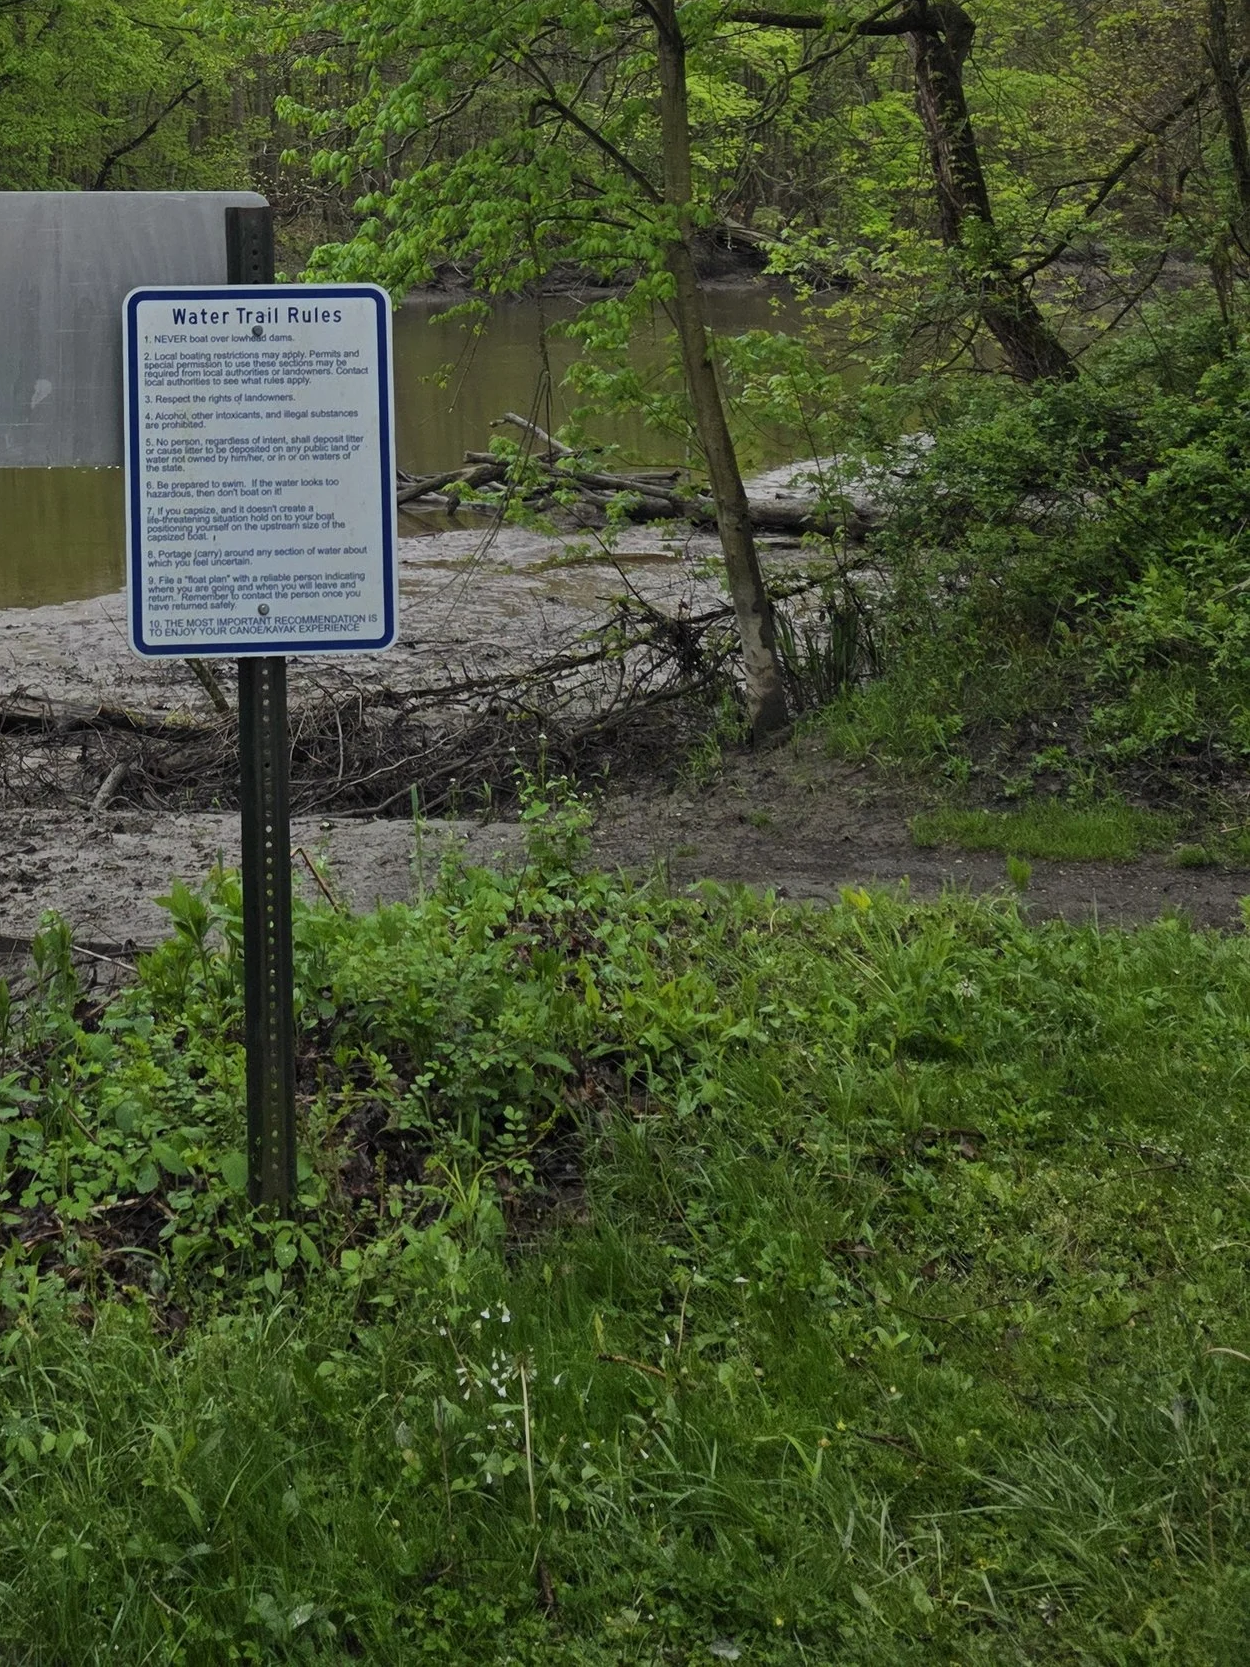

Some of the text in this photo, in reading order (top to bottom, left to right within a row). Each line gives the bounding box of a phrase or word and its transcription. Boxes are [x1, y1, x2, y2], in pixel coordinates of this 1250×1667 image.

[173, 307, 341, 324] Water Trail Rules
[154, 335, 187, 343] NEVER
[190, 335, 208, 343] boat
[232, 334, 266, 342] lowhead
[269, 334, 294, 342] dams.
[155, 352, 177, 360] Local
[180, 351, 211, 361] boating
[214, 351, 259, 359] restrictions
[262, 352, 280, 361] may
[282, 350, 308, 360] apply.
[309, 350, 341, 358] Permits
[144, 360, 174, 370] special
[176, 360, 222, 370] permission
[253, 359, 276, 367] these
[279, 359, 314, 367] sections
[316, 360, 334, 369] may
[336, 358, 347, 366] be
[144, 369, 179, 379] required
[182, 368, 201, 376] from
[203, 368, 223, 376] local
[226, 368, 269, 376] authorities
[282, 367, 333, 375] landowners.
[336, 367, 368, 375] Contact
[145, 378, 164, 386] local
[167, 377, 210, 386] authorities
[241, 376, 261, 384] what
[264, 376, 284, 384] rules
[287, 376, 311, 386] apply.
[156, 395, 190, 405] Respect
[209, 394, 232, 404] rights
[234, 394, 242, 402] of
[245, 393, 295, 402] landowners.
[155, 412, 188, 421] Alcohol,
[191, 411, 213, 419] other
[216, 411, 262, 420] intoxicants,
[266, 410, 281, 418] and
[284, 410, 308, 420] illegal
[311, 409, 358, 418] substances
[162, 420, 206, 431] prohibited.
[156, 438, 168, 446] No
[171, 439, 202, 448] person,
[205, 436, 249, 447] regardless
[252, 436, 260, 444] of
[262, 436, 288, 445] intent,
[291, 435, 310, 444] shall
[313, 435, 343, 445] deposit
[346, 434, 364, 442] litter
[146, 464, 185, 472] the state.
[157, 481, 168, 489] Be
[172, 480, 209, 490] prepared
[222, 480, 246, 488] swim.
[252, 479, 257, 487] If
[259, 479, 273, 487] the
[275, 479, 298, 487] water
[301, 478, 323, 486] looks
[147, 489, 193, 498] hazardous,
[196, 489, 215, 497] then
[218, 488, 238, 496] don't
[240, 488, 259, 496] boat
[274, 488, 282, 496] it!
[158, 507, 163, 515] If
[166, 509, 181, 517] you
[183, 506, 218, 516] capsize,
[221, 506, 237, 514] and
[246, 505, 277, 513] doesn't
[279, 505, 306, 513] create
[147, 532, 208, 543] capsized boat.
[158, 550, 192, 560] Portage
[194, 549, 222, 560] (carry)
[224, 549, 254, 557] around
[257, 550, 272, 558] any
[275, 548, 304, 556] section
[307, 547, 315, 555] of
[318, 547, 341, 555] water
[343, 546, 367, 554] about
[148, 557, 252, 569] which you feel uncertain.
[159, 576, 174, 584] File
[185, 576, 206, 584] "float
[209, 575, 230, 585] plan"
[233, 574, 250, 583] with
[260, 574, 291, 582] reliable
[293, 575, 322, 584] person
[325, 572, 365, 582] indicating
[148, 584, 174, 592] where
[177, 586, 192, 594] you
[211, 583, 235, 593] going
[237, 583, 253, 591] and
[256, 582, 278, 590] when
[281, 584, 297, 592] you
[315, 581, 337, 589] leave
[340, 581, 356, 589] and
[182, 592, 228, 601] Remember
[231, 592, 239, 600] to
[242, 592, 272, 600] contact
[275, 591, 288, 599] the
[291, 592, 320, 601] person
[346, 591, 361, 600] you
[149, 601, 237, 611] have returned safely.
[150, 614, 377, 628] 10. THE MOST IMPORTANT RECOMMENDATION IS
[150, 624, 360, 637] TO ENJOY YOUR CANOE/KAYAK EXPERIENCE
